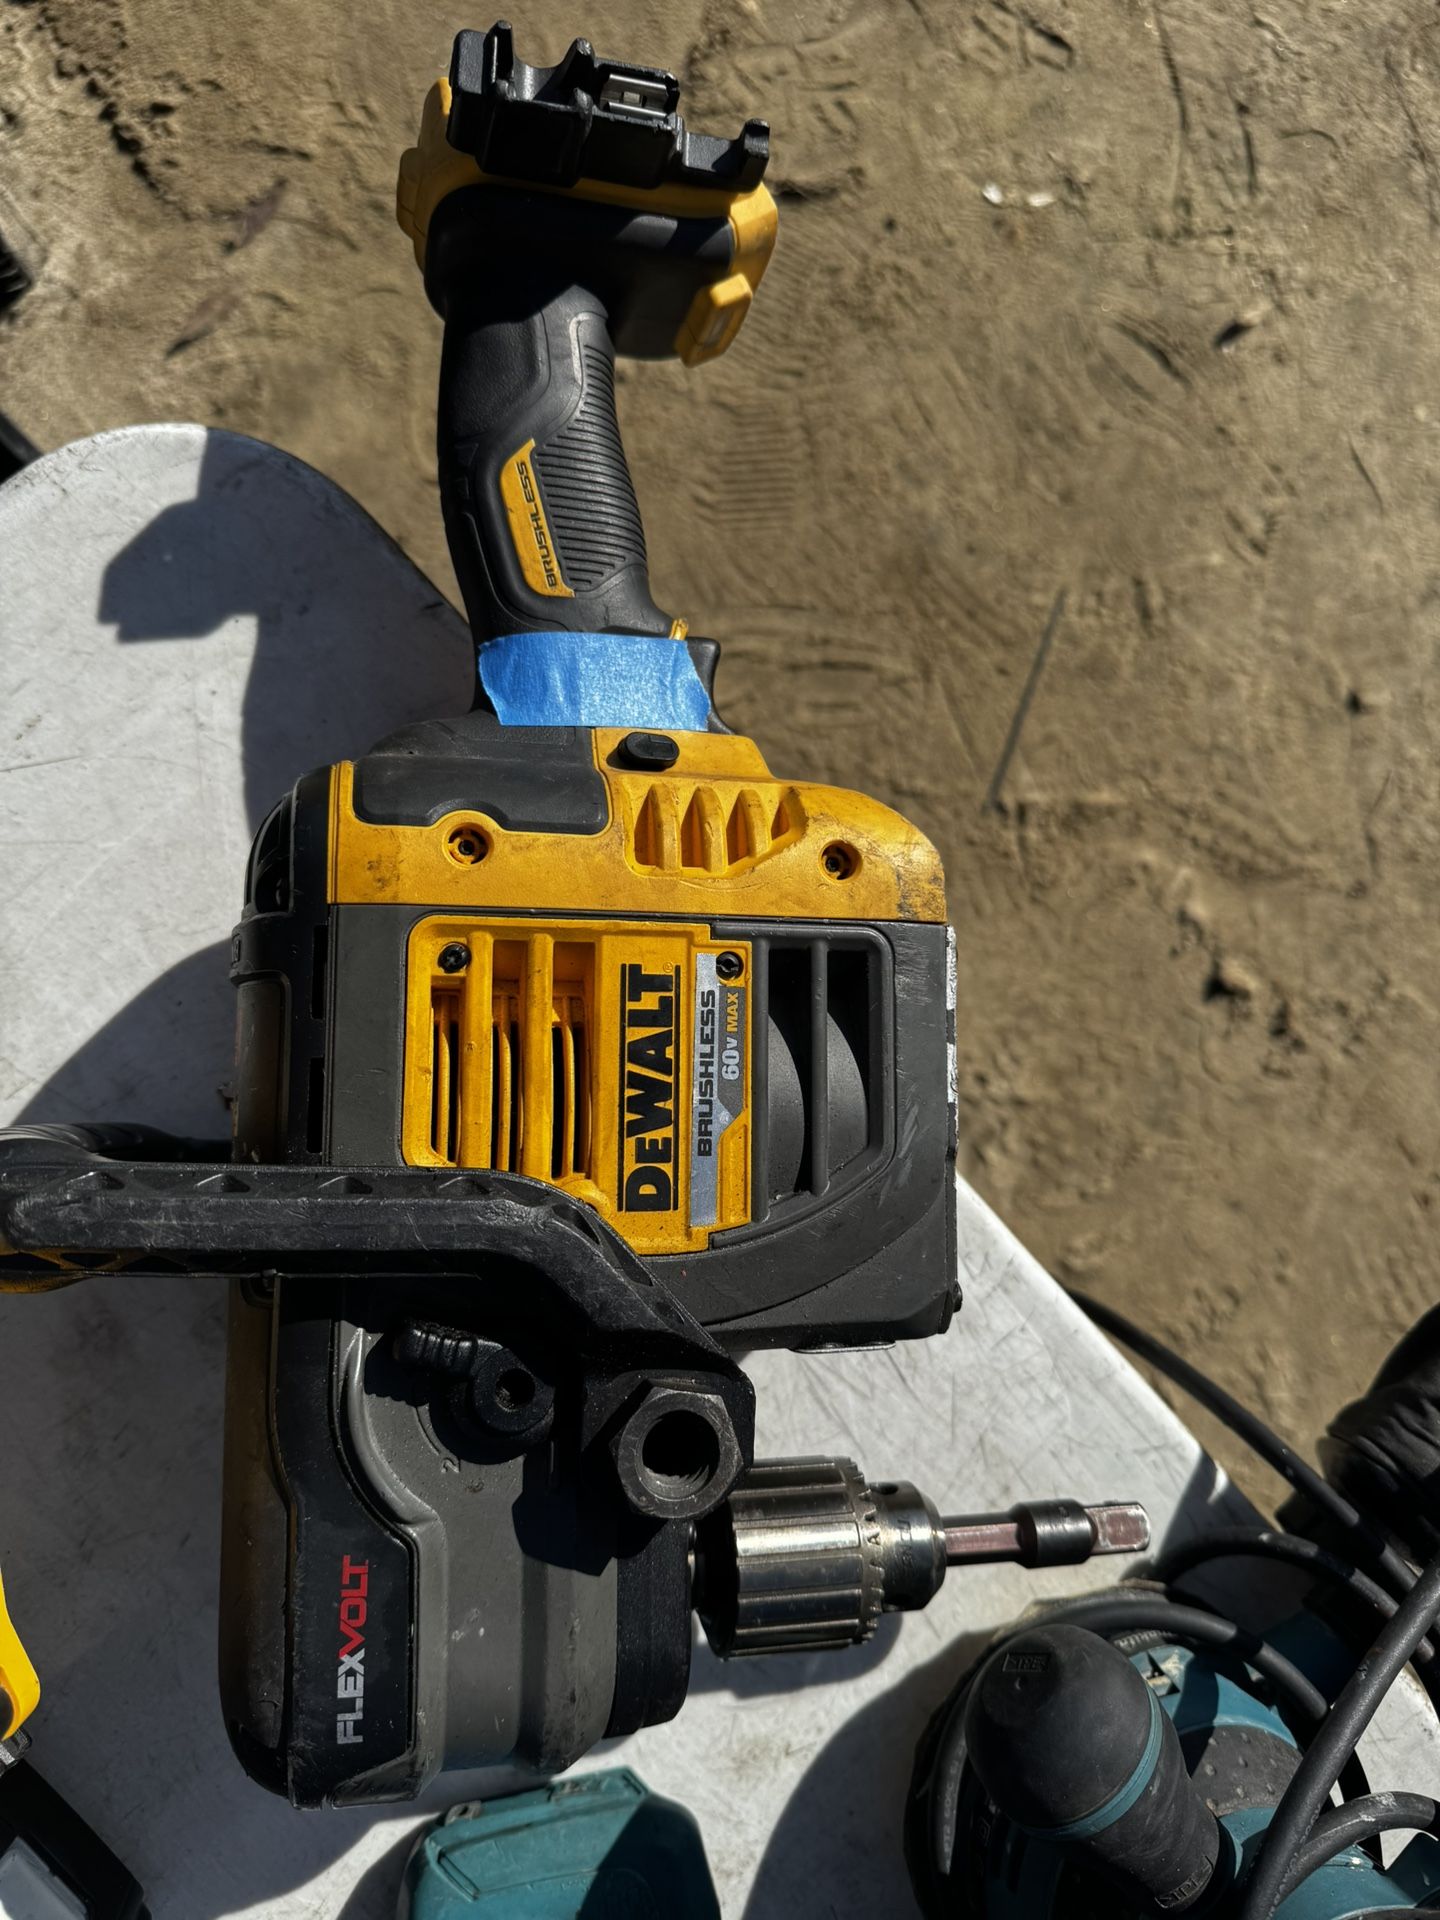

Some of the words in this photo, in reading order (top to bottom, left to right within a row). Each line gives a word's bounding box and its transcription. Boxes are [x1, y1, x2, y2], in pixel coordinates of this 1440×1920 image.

[517, 461, 558, 588] BRUSHLESS
[625, 963, 674, 1212] DEWALT
[696, 989, 716, 1158] BRUSHLESS
[724, 992, 739, 1033] MAX
[336, 1555, 369, 1745] FLEXVOLT
